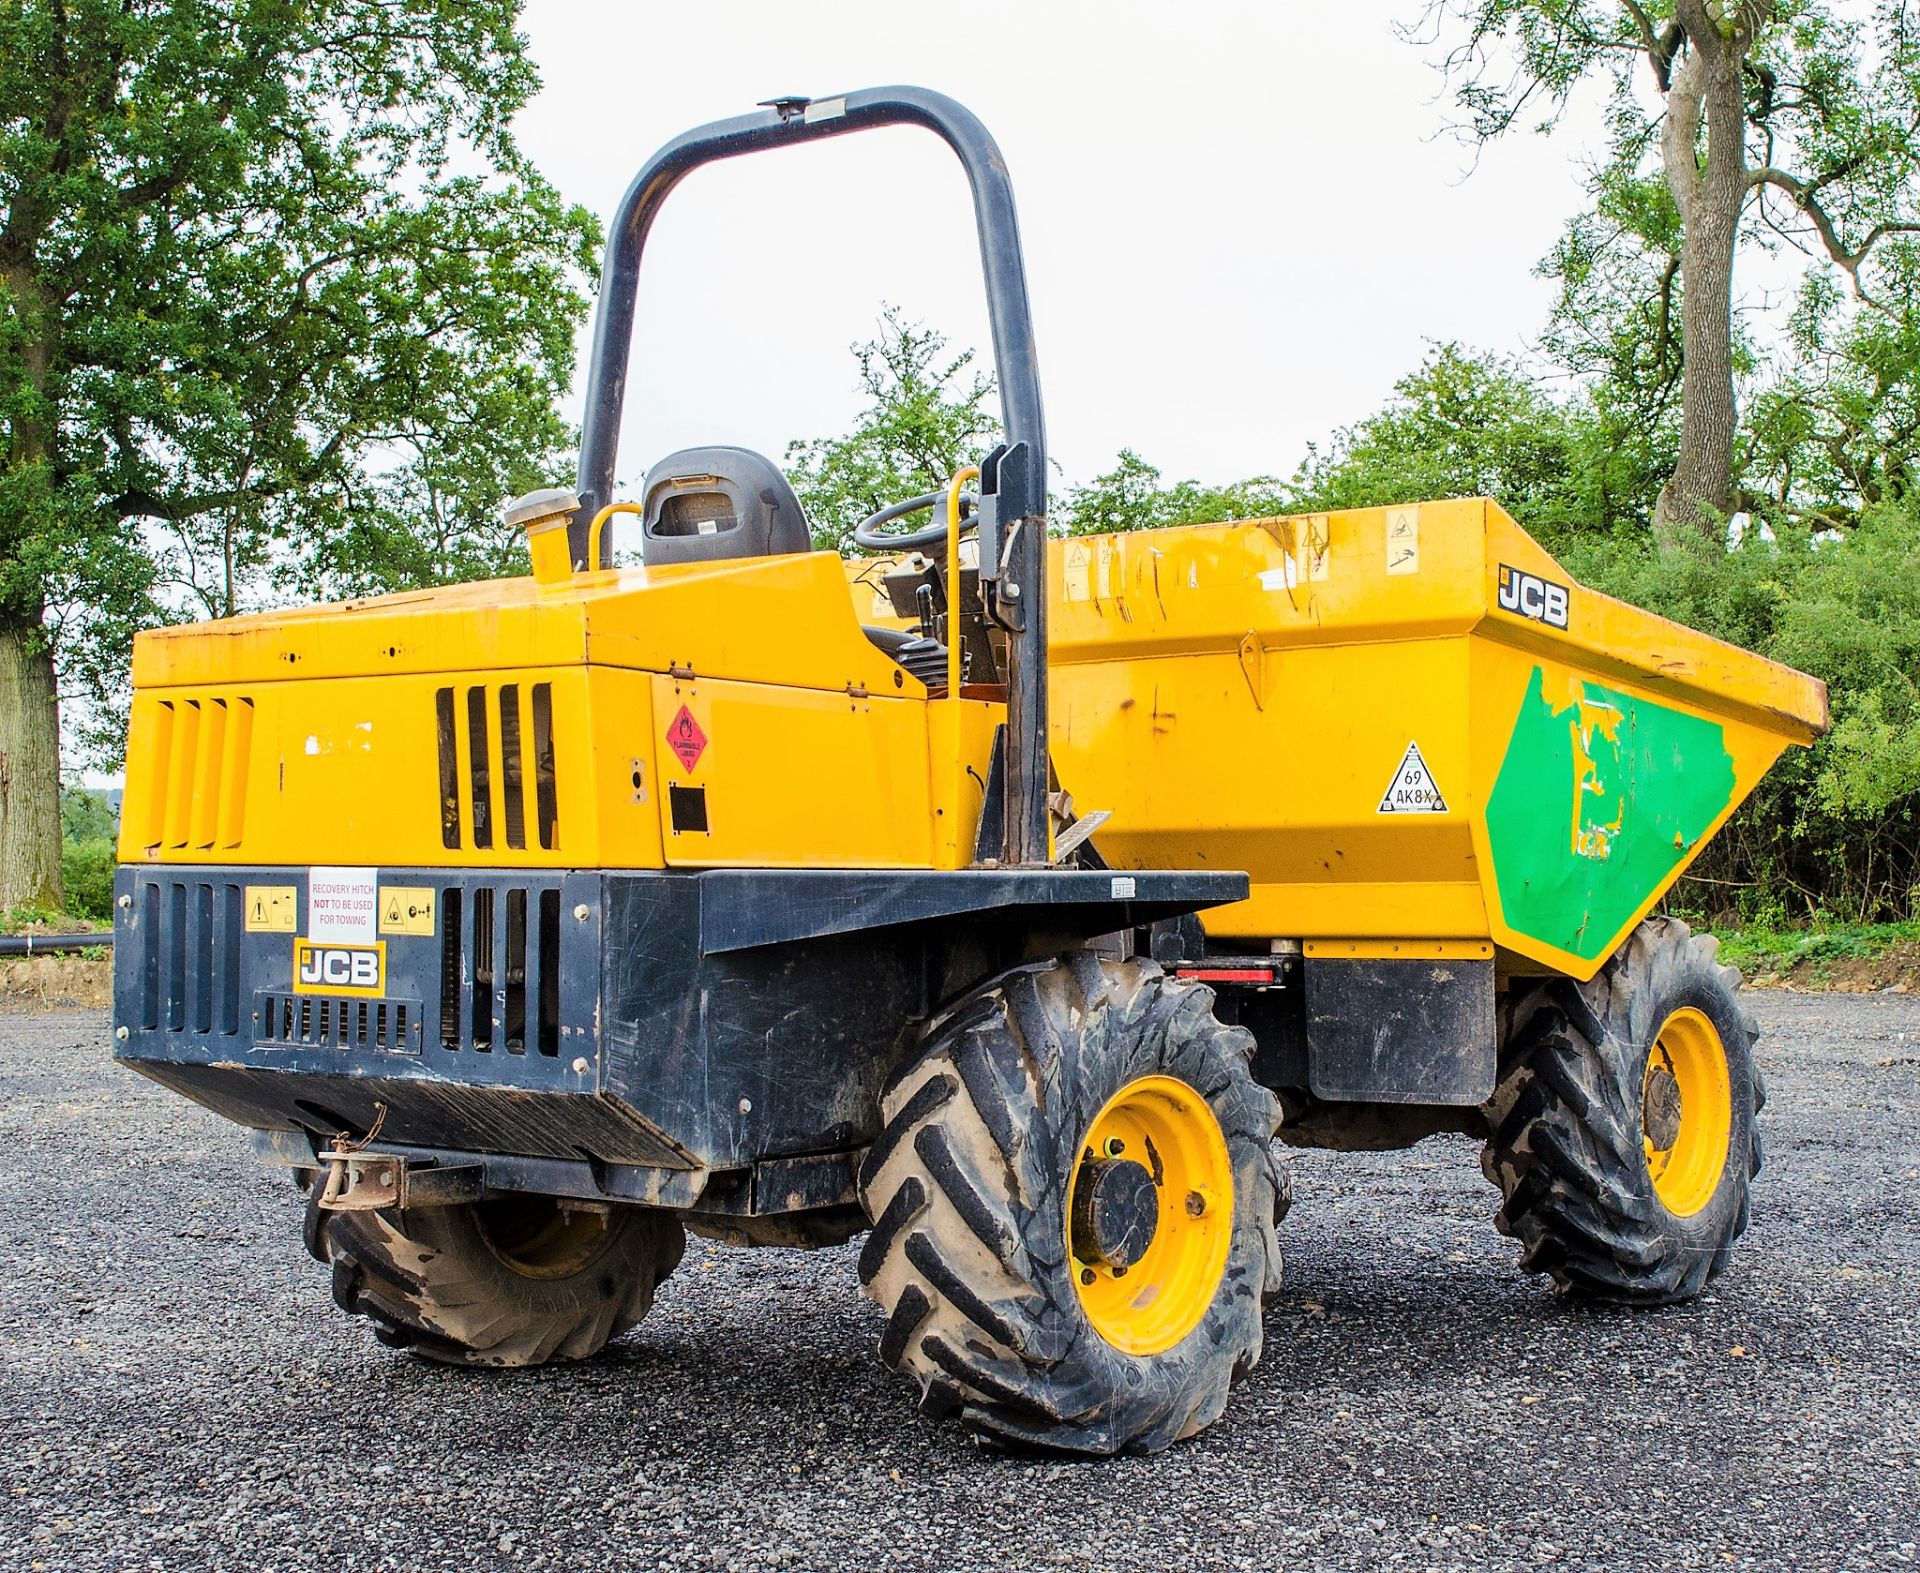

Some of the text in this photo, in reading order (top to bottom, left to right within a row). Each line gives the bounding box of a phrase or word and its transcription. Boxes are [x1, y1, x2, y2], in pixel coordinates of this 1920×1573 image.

[1499, 571, 1568, 627] JCB
[1404, 770, 1421, 785] 69
[1396, 789, 1432, 804] AK8X
[312, 884, 374, 895] RECOVERY HITCH
[313, 899, 373, 910] NOT TO BE USED
[320, 915, 366, 925] FOR TOWING
[301, 950, 378, 985] JCB
